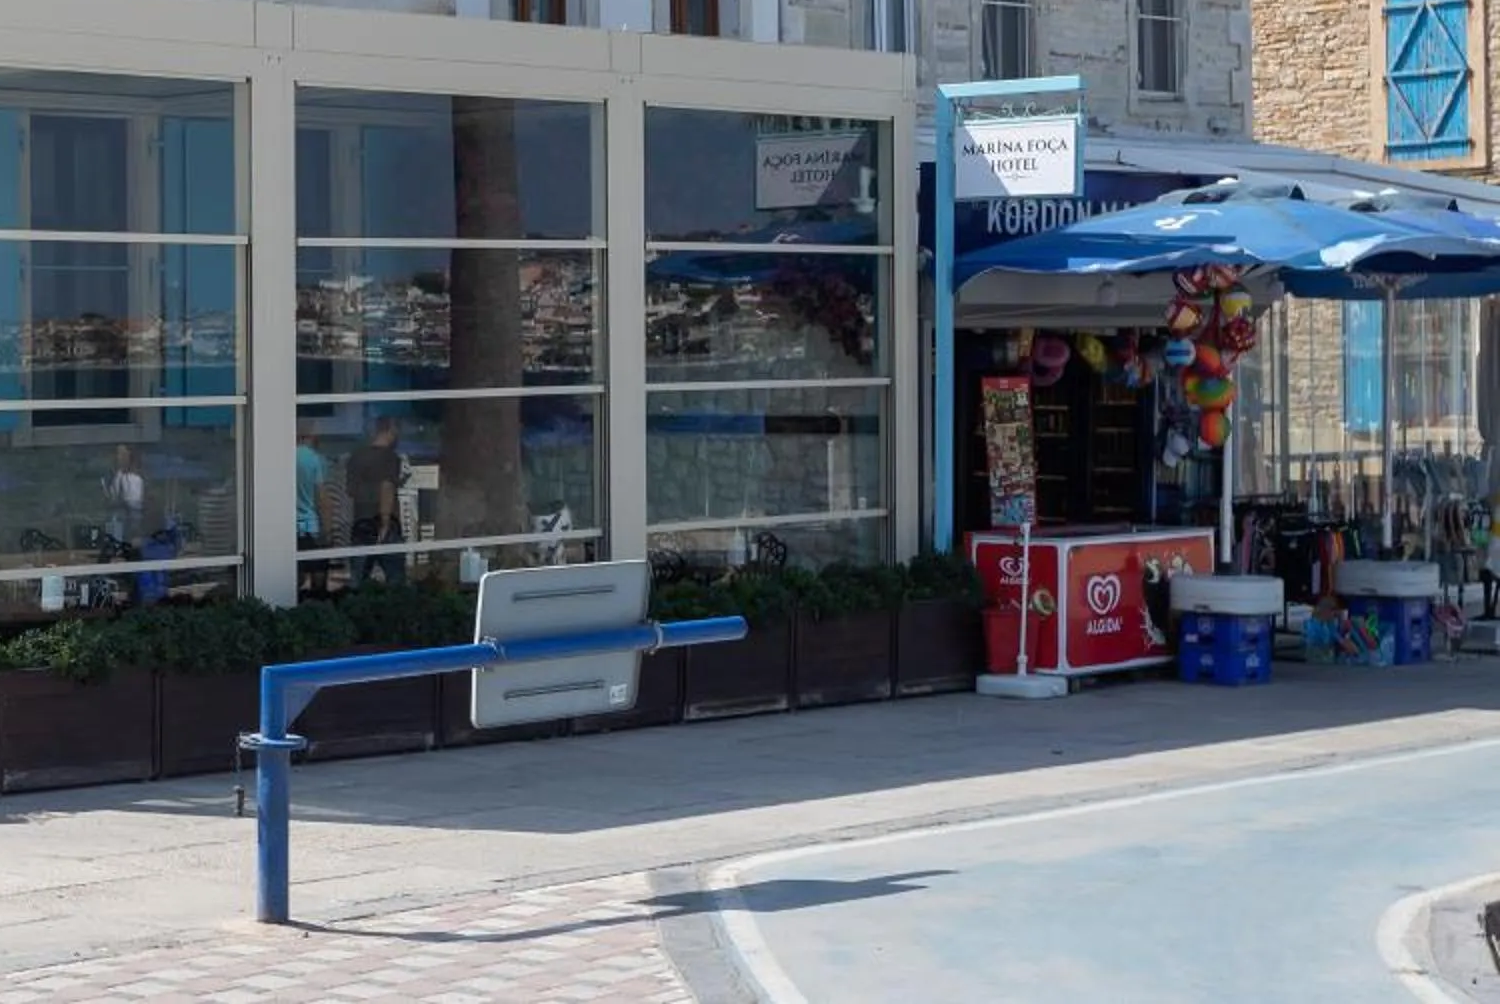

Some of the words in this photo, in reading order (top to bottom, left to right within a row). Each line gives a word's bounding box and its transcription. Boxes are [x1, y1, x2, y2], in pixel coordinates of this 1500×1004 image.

[963, 141, 1023, 156] MARİNA
[1027, 138, 1068, 154] FOÇA
[991, 158, 1039, 173] HOTEL
